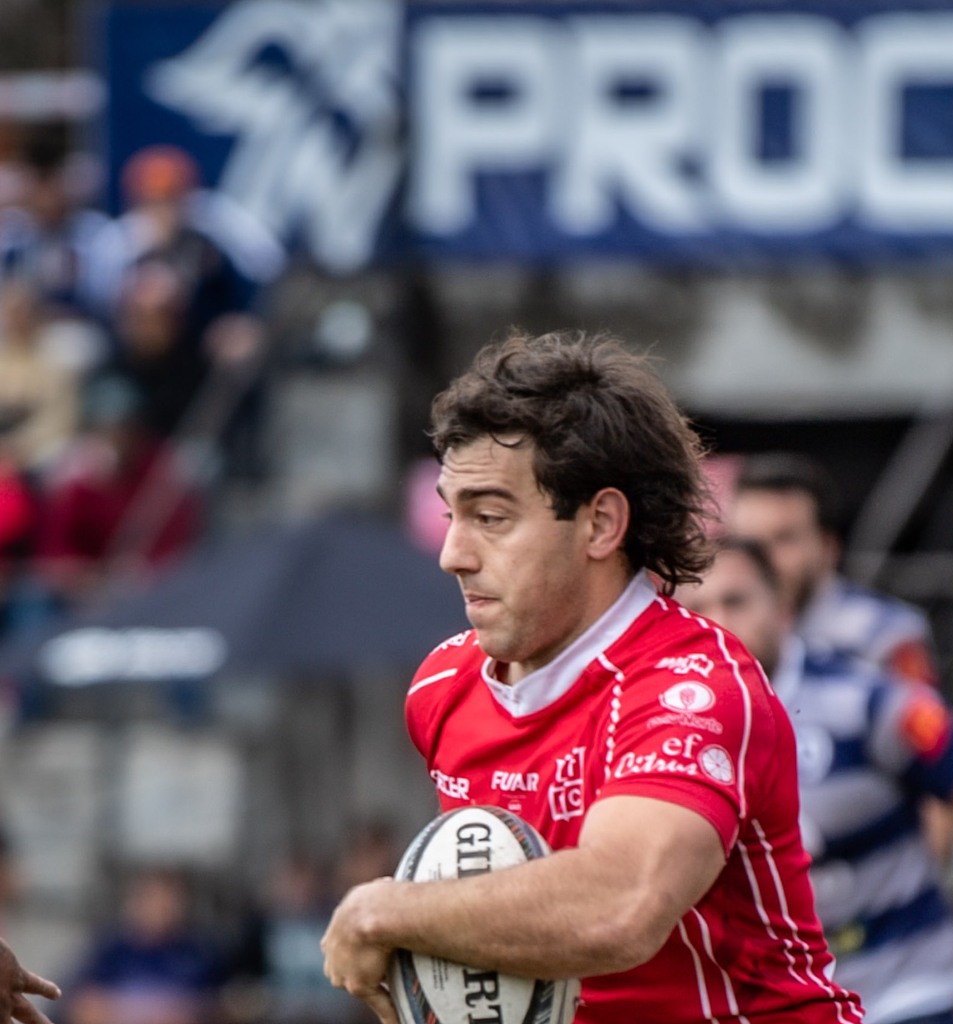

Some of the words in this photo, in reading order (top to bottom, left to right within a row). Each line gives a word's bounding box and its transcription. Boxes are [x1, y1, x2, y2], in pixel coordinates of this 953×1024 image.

[662, 734, 703, 758] ef
[614, 752, 698, 778] Citrus
[491, 770, 539, 791] FUAR
